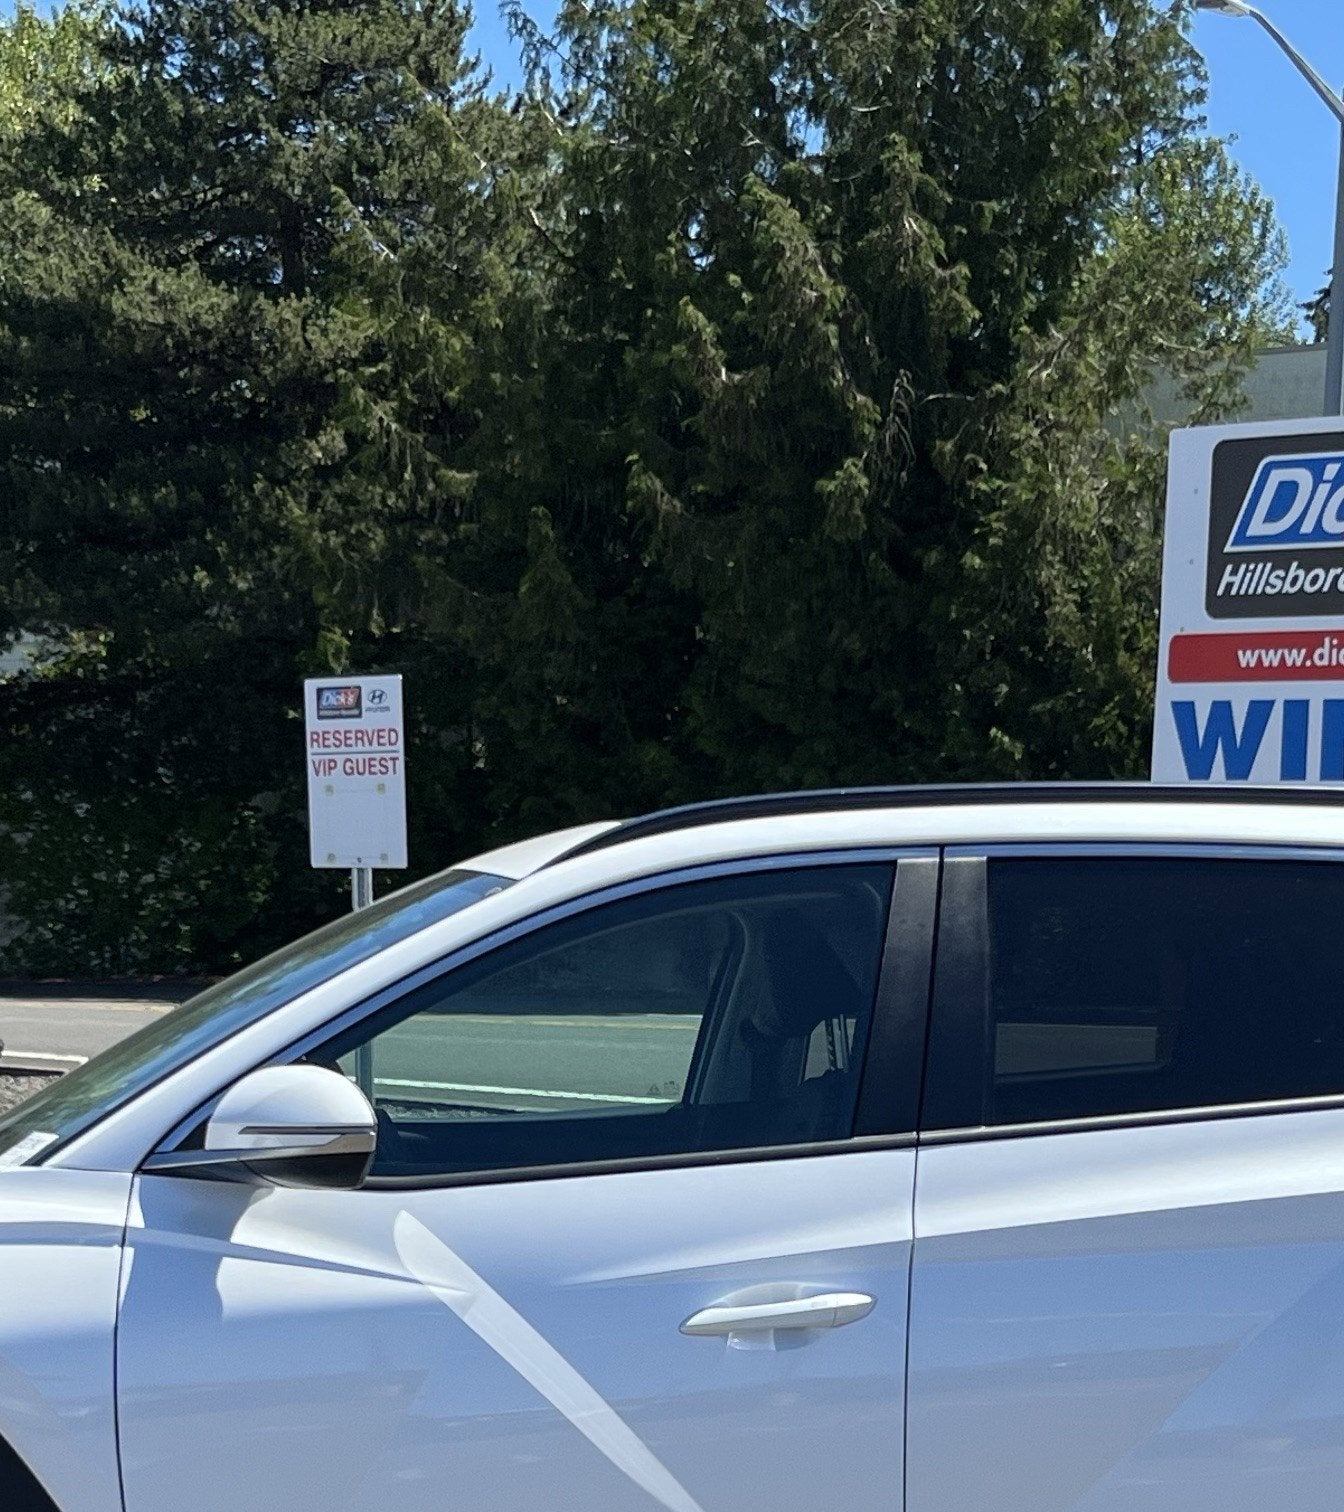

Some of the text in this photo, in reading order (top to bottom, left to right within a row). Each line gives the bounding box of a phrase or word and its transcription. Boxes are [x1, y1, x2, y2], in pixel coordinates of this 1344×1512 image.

[310, 728, 399, 749] RESERVED
[311, 757, 400, 777] VIP GUEST
